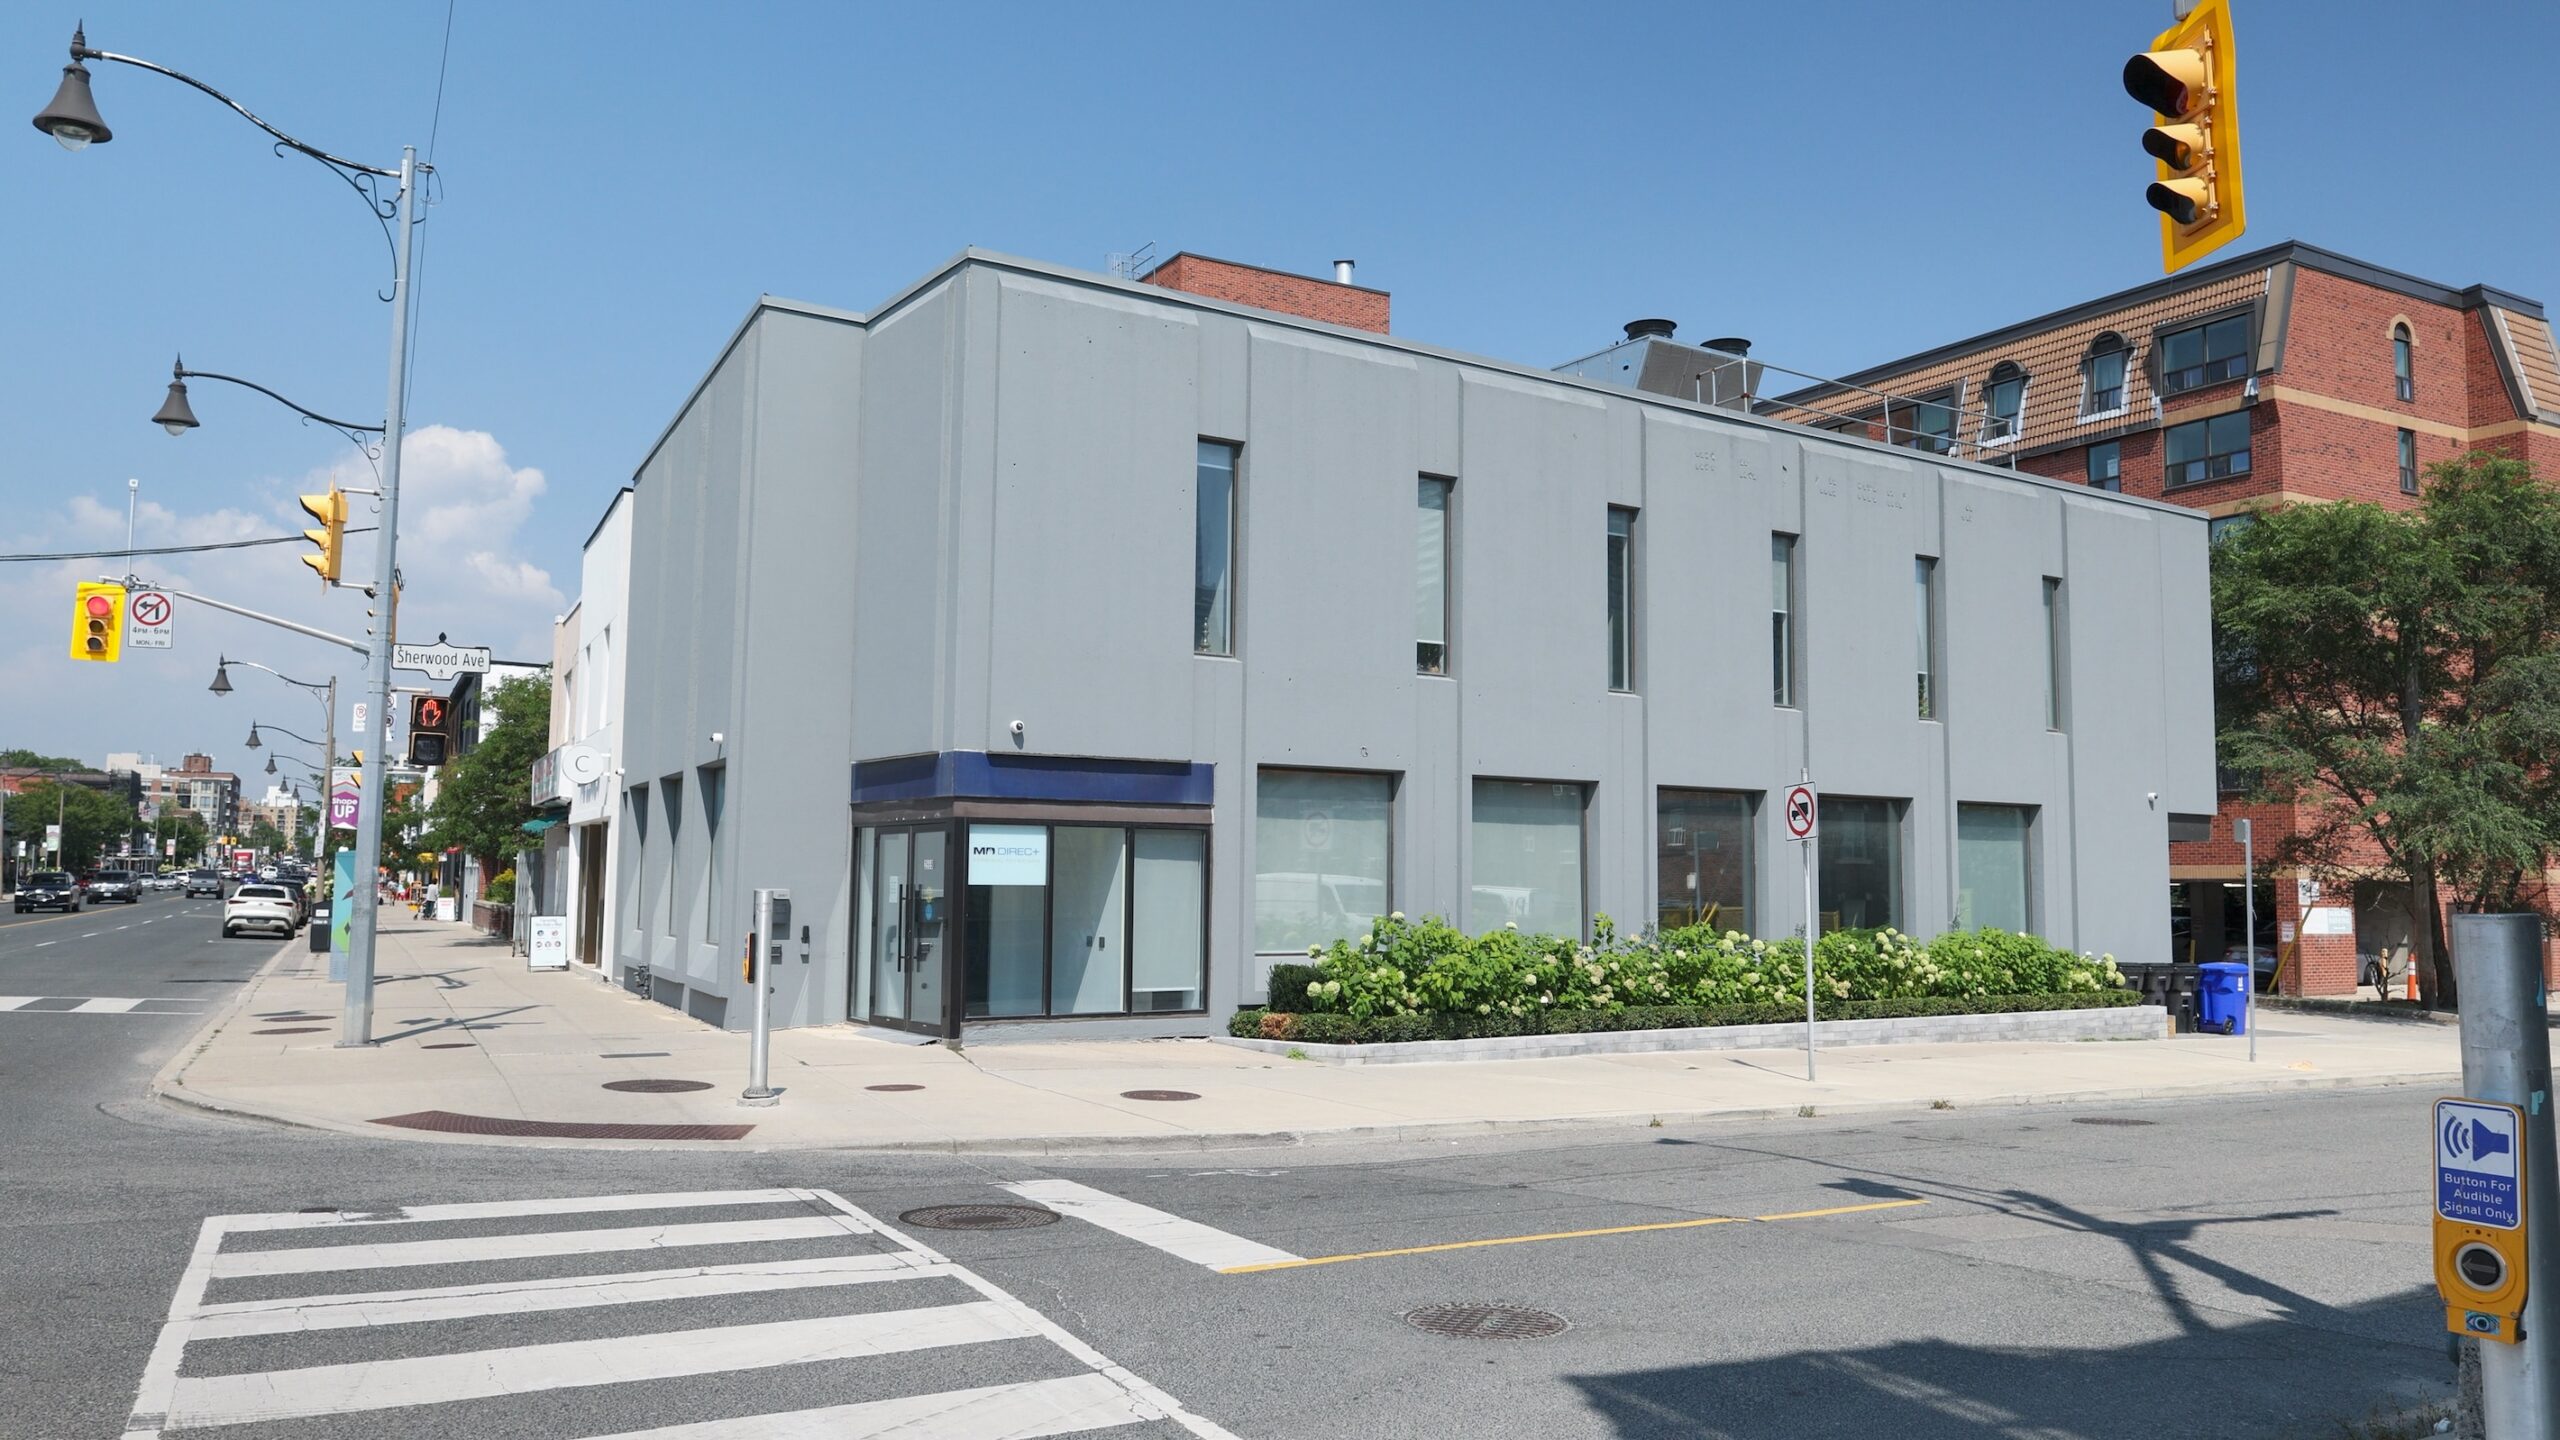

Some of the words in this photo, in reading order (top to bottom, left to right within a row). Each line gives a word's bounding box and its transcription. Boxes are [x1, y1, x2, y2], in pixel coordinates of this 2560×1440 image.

[397, 649, 458, 666] Sherwood
[462, 653, 485, 668] Ave
[575, 755, 590, 773] C
[331, 797, 358, 807] Shape
[334, 804, 356, 819] UP
[2444, 1172, 2487, 1189] Button
[2490, 1180, 2512, 1192] For
[2453, 1188, 2503, 1205] Audible
[2444, 1200, 2481, 1216] Signal
[2485, 1207, 2513, 1222] Only
